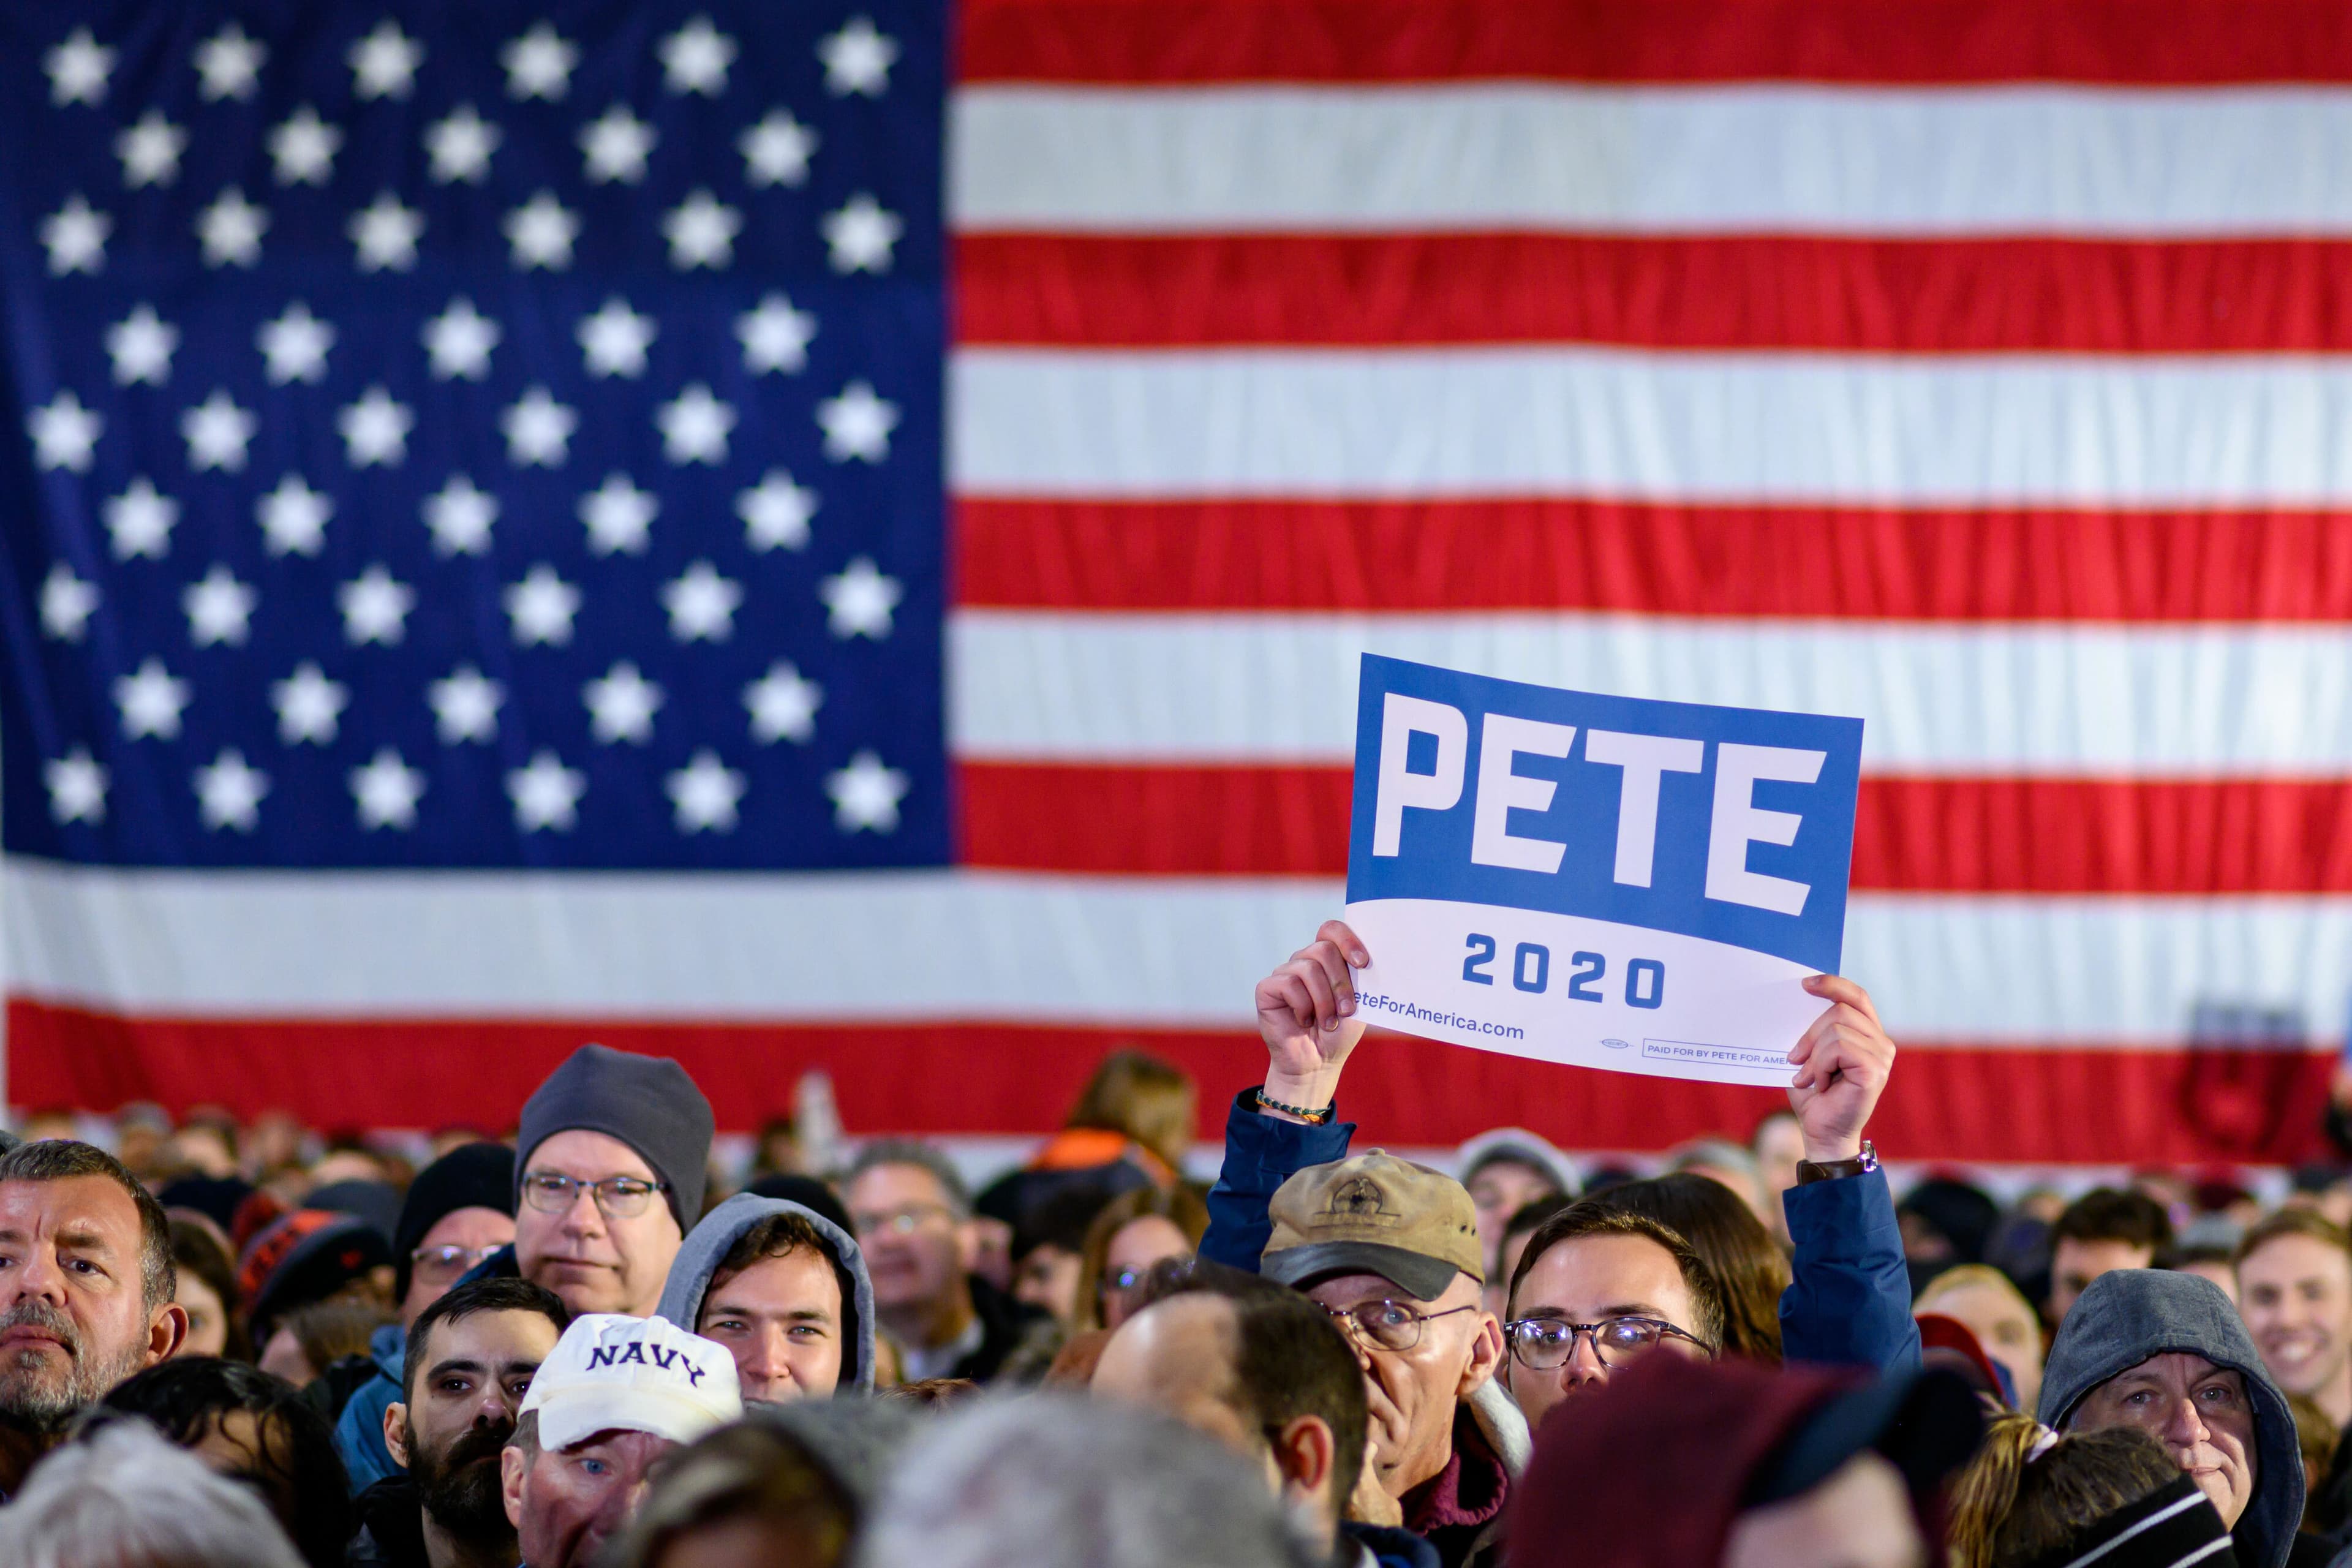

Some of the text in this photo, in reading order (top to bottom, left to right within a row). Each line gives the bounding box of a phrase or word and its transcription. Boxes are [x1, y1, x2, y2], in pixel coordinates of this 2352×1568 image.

[1372, 692, 1827, 917] PETE
[1462, 932, 1665, 1010] 2020
[1354, 992, 1525, 1039] eteForAmerica.com
[1647, 1044, 1671, 1055] PAID
[1673, 1047, 1694, 1057] FOR
[1696, 1049, 1709, 1058] BY
[1711, 1051, 1738, 1061] PETE
[1740, 1054, 1761, 1063] FOR
[585, 1341, 706, 1388] NAVY
